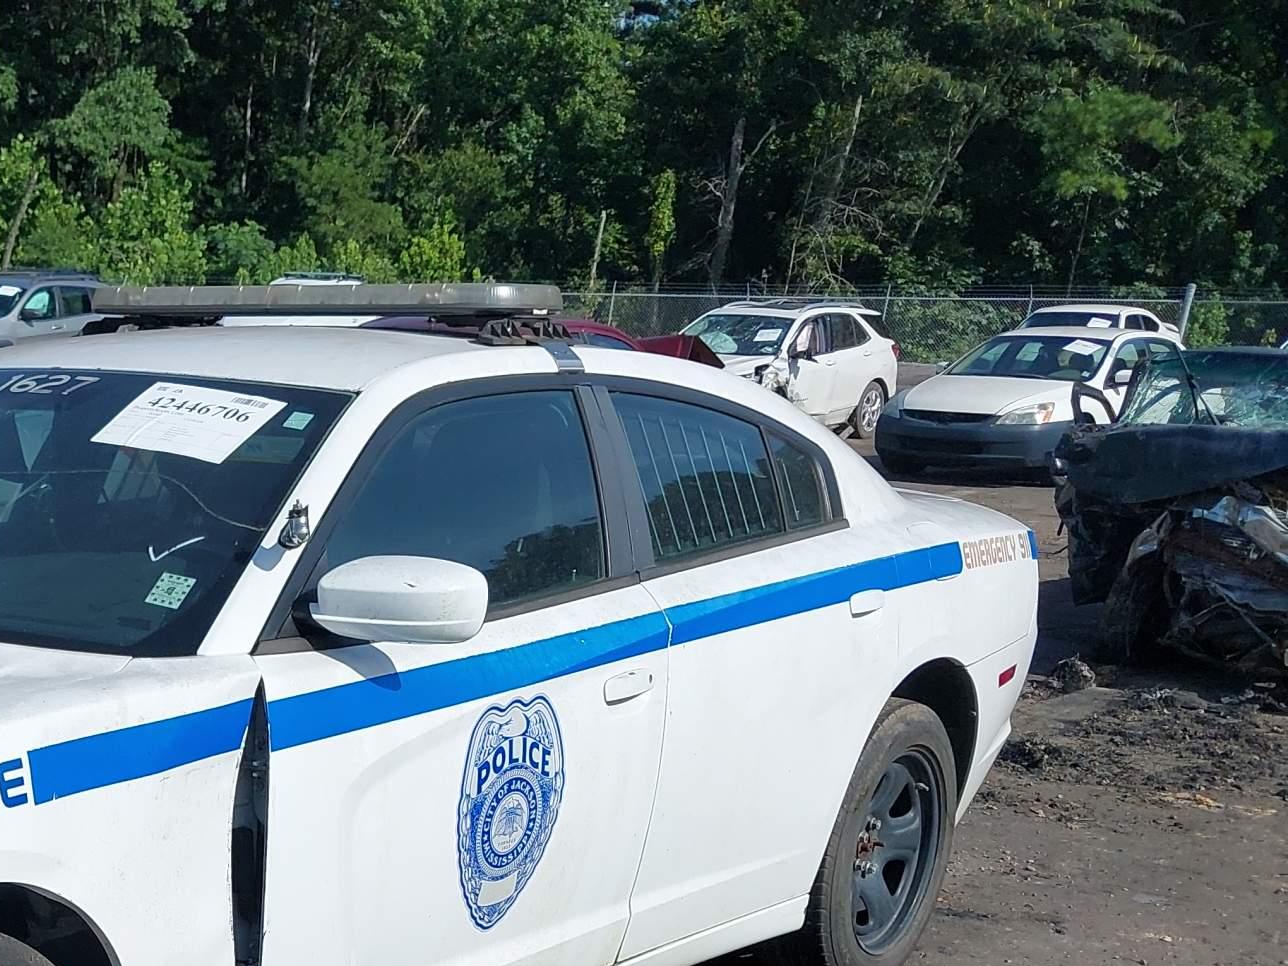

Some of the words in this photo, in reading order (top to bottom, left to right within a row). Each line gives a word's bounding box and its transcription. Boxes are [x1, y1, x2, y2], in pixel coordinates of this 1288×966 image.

[148, 396, 253, 423] 42446706
[477, 736, 551, 795] POLICE
[483, 798, 497, 832] CITY
[497, 783, 509, 799] OF
[510, 780, 537, 820] JACKSON
[482, 830, 532, 867] MISSISSIPPI
